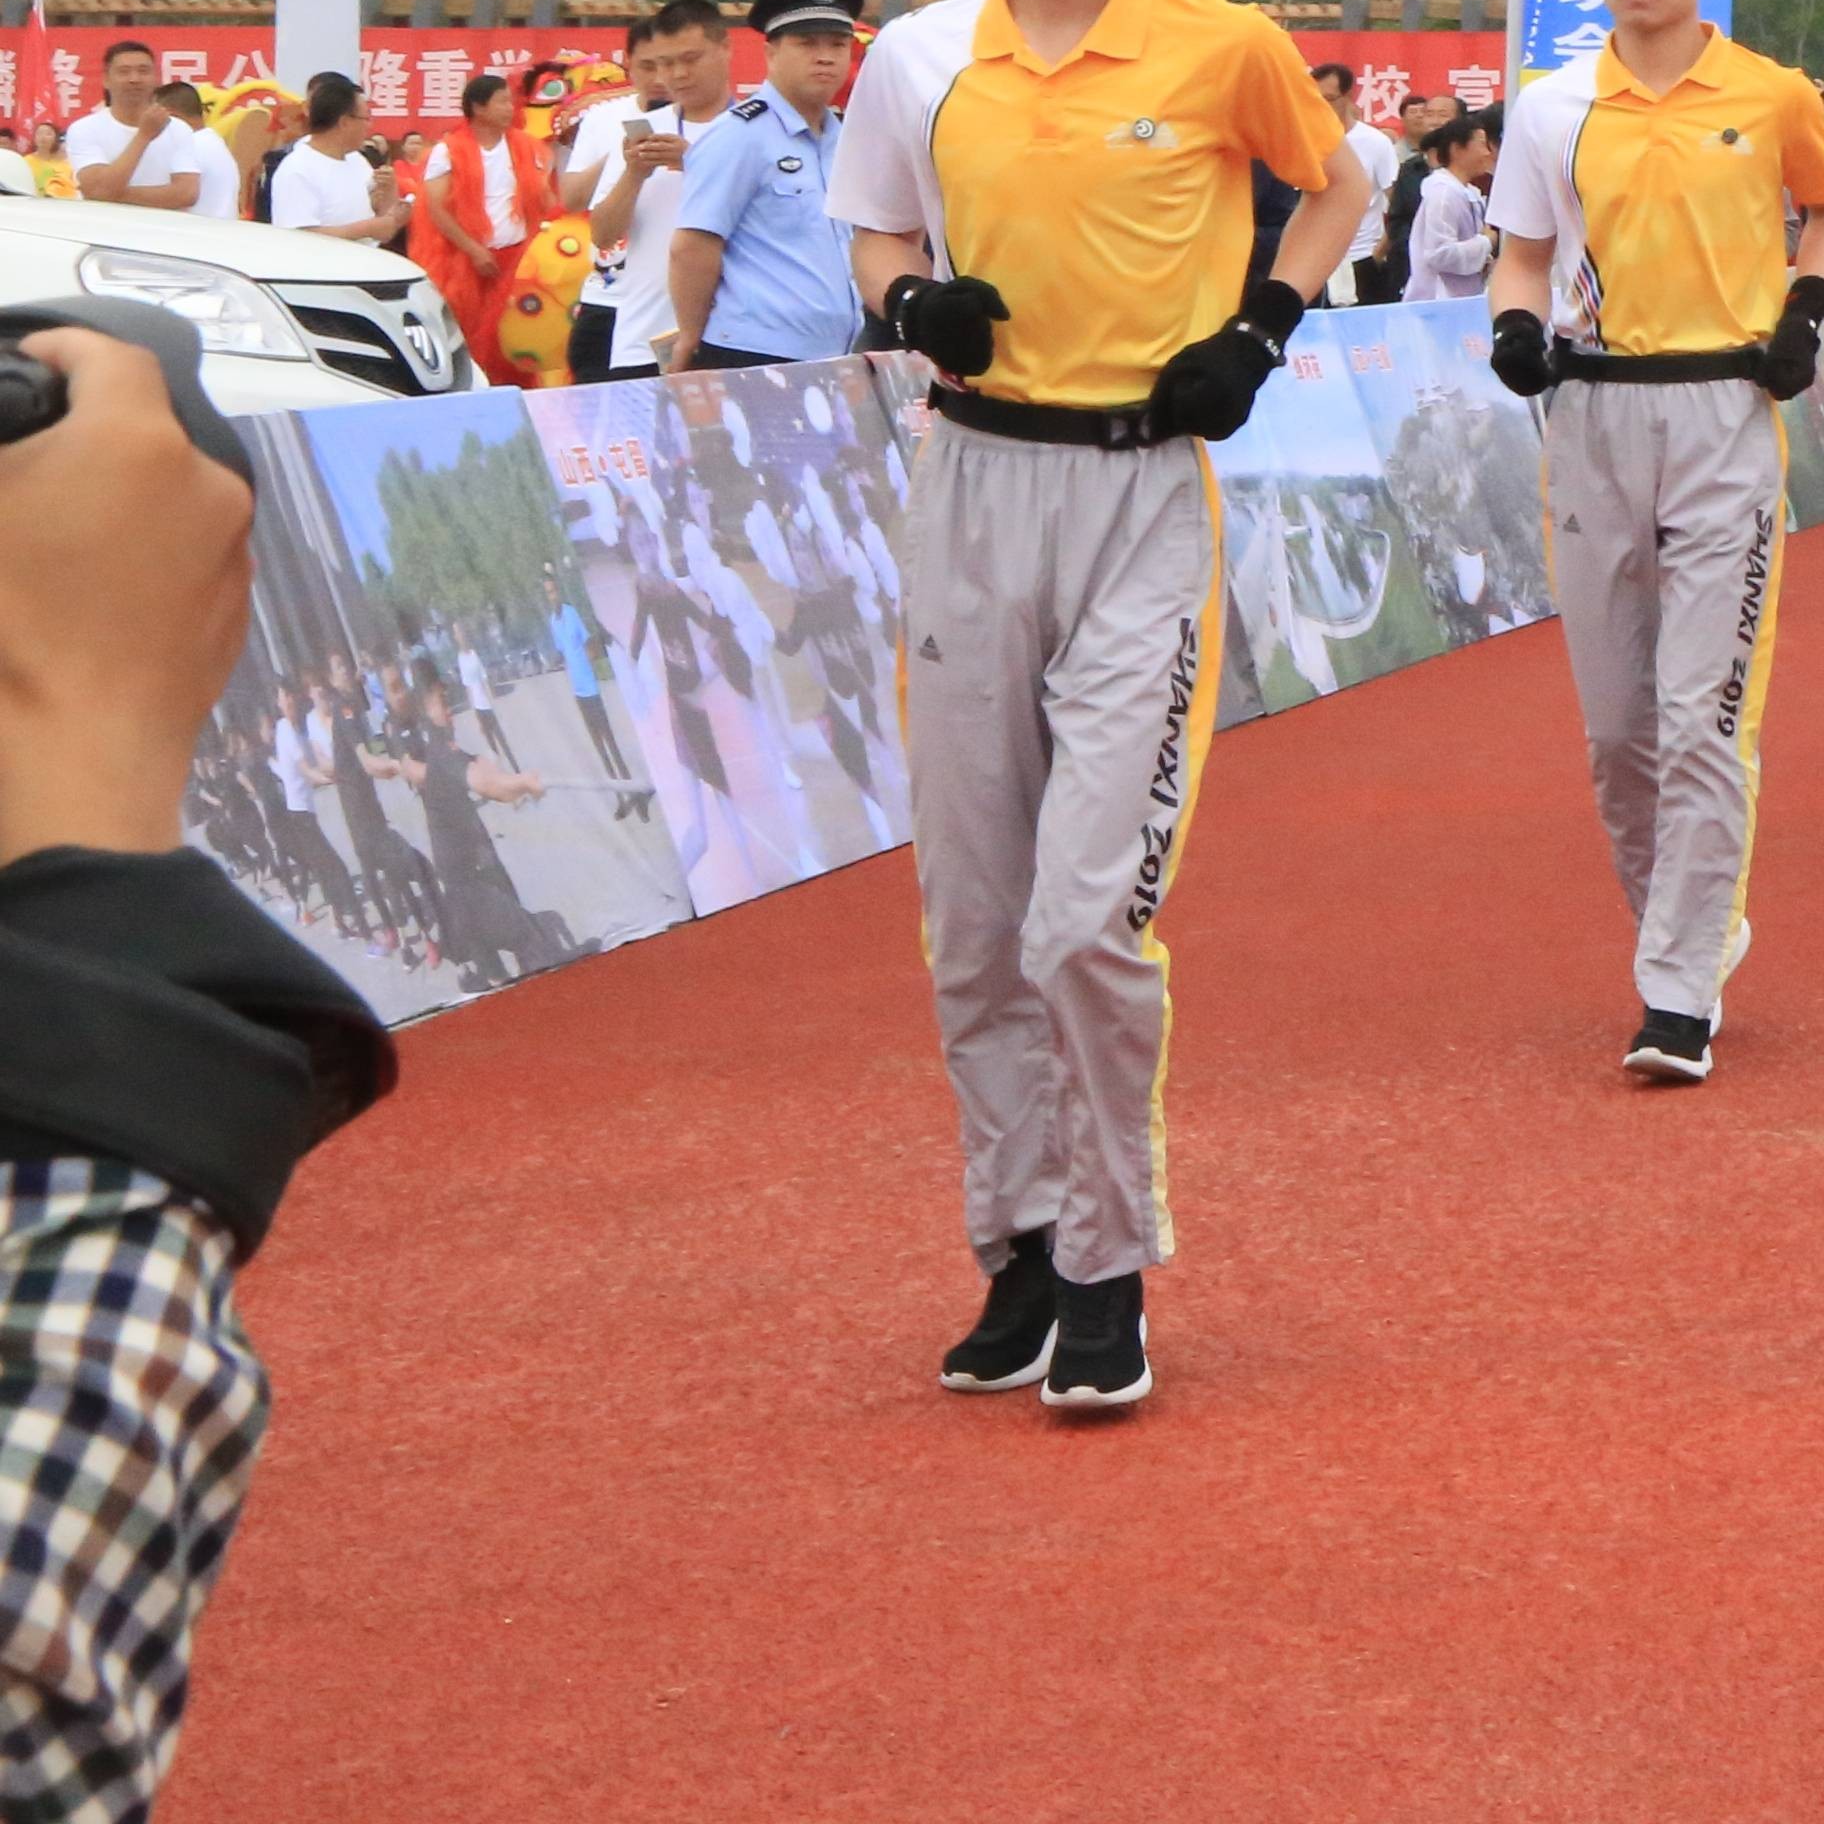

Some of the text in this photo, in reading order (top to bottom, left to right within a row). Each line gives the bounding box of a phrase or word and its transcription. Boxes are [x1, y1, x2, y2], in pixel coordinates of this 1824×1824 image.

[1717, 508, 1773, 739] SHANXI 2019
[1126, 617, 1197, 933] SHANXI 2019
